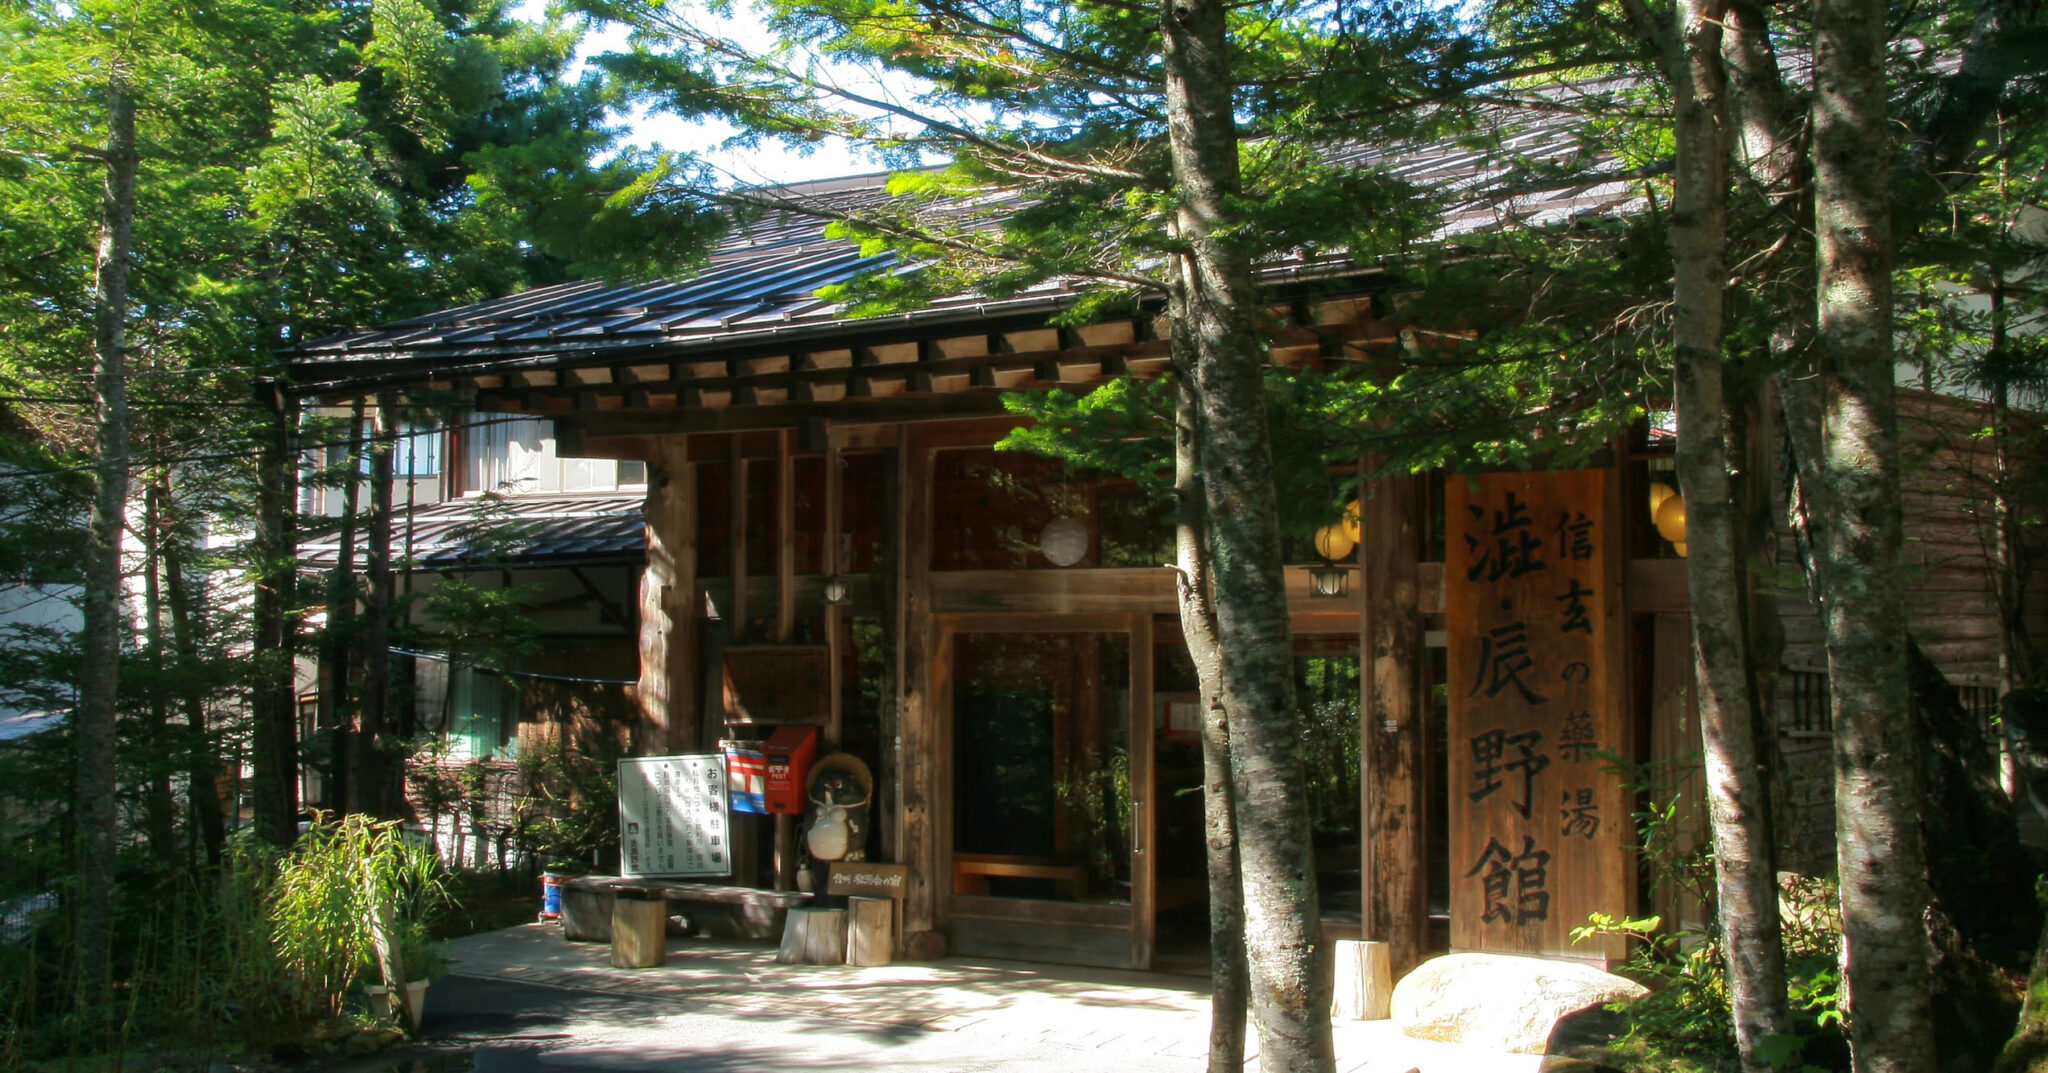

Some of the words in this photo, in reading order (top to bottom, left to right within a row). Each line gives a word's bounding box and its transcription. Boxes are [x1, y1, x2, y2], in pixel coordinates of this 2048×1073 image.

[707, 767, 722, 863] お客様駐車場
